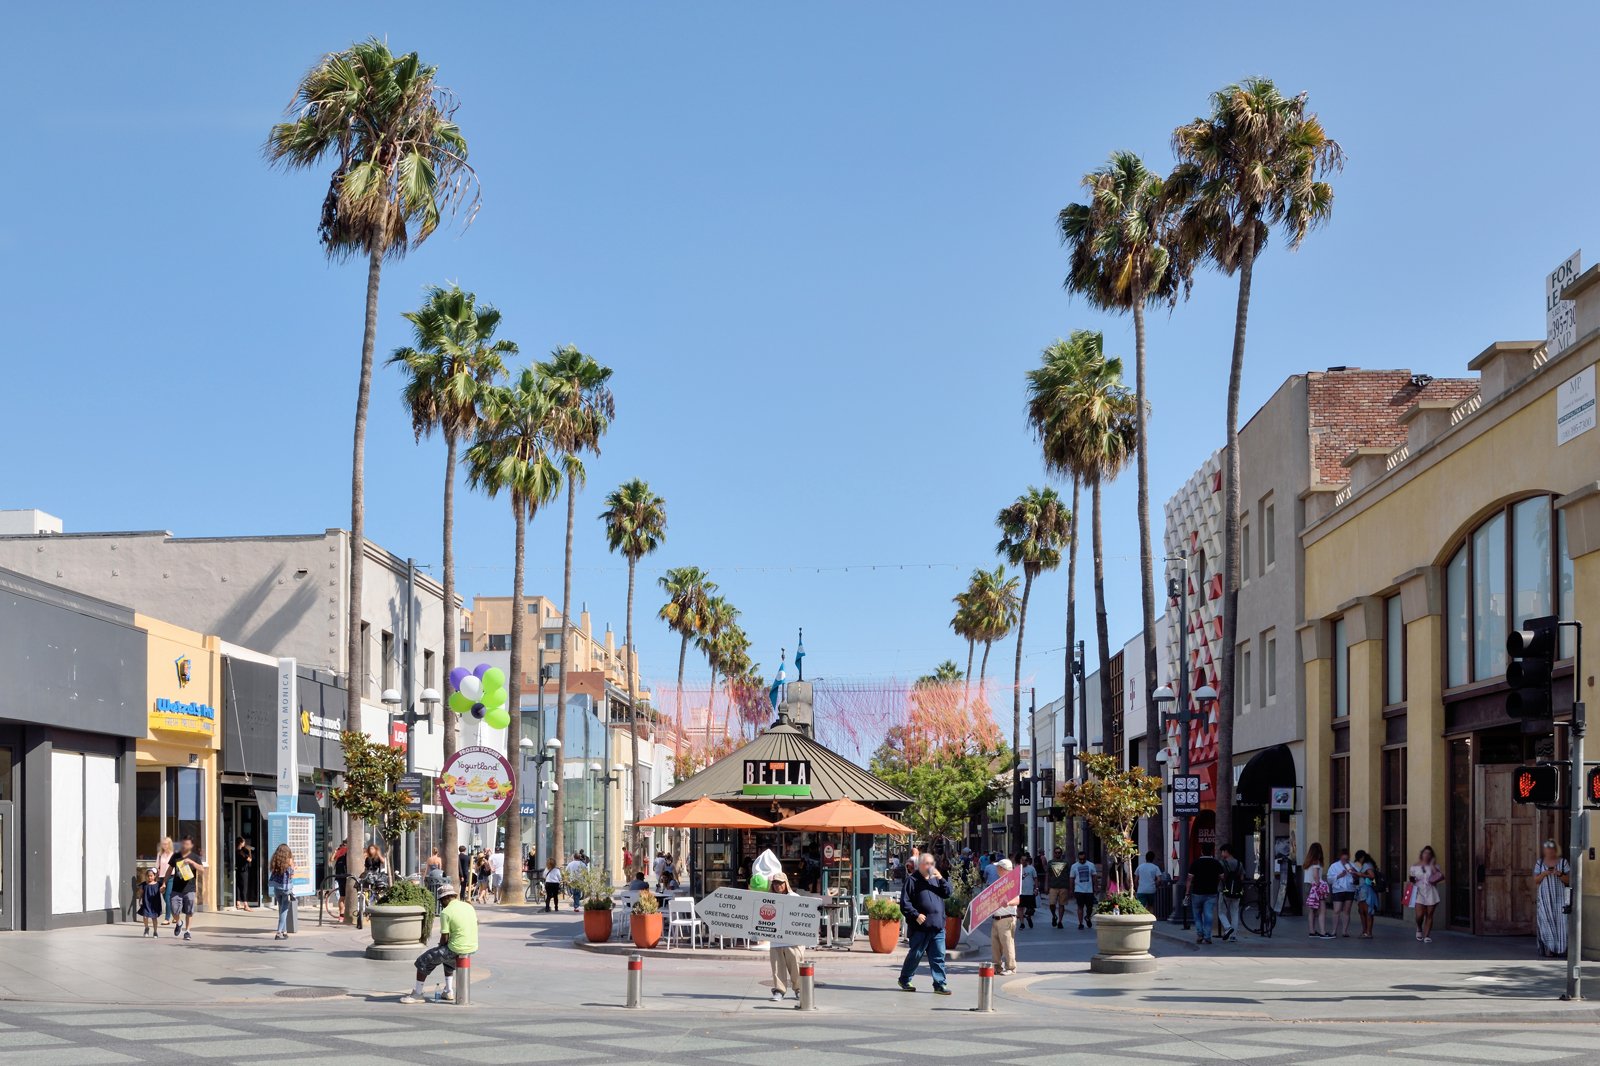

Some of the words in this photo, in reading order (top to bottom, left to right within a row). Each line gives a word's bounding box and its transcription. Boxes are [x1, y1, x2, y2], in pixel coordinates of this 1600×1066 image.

[1551, 259, 1573, 289] FOR
[1552, 305, 1576, 340] 395-730
[459, 746, 480, 756] FROZEN
[480, 746, 502, 759] YOGURT
[457, 760, 499, 773] Yogurtland
[746, 762, 806, 785] BELLA
[519, 806, 534, 814] ids
[723, 893, 742, 901] CREAM
[704, 910, 730, 918] GREETING
[711, 920, 743, 929] SOUVENIERS
[784, 929, 816, 938] BEVERAGES
